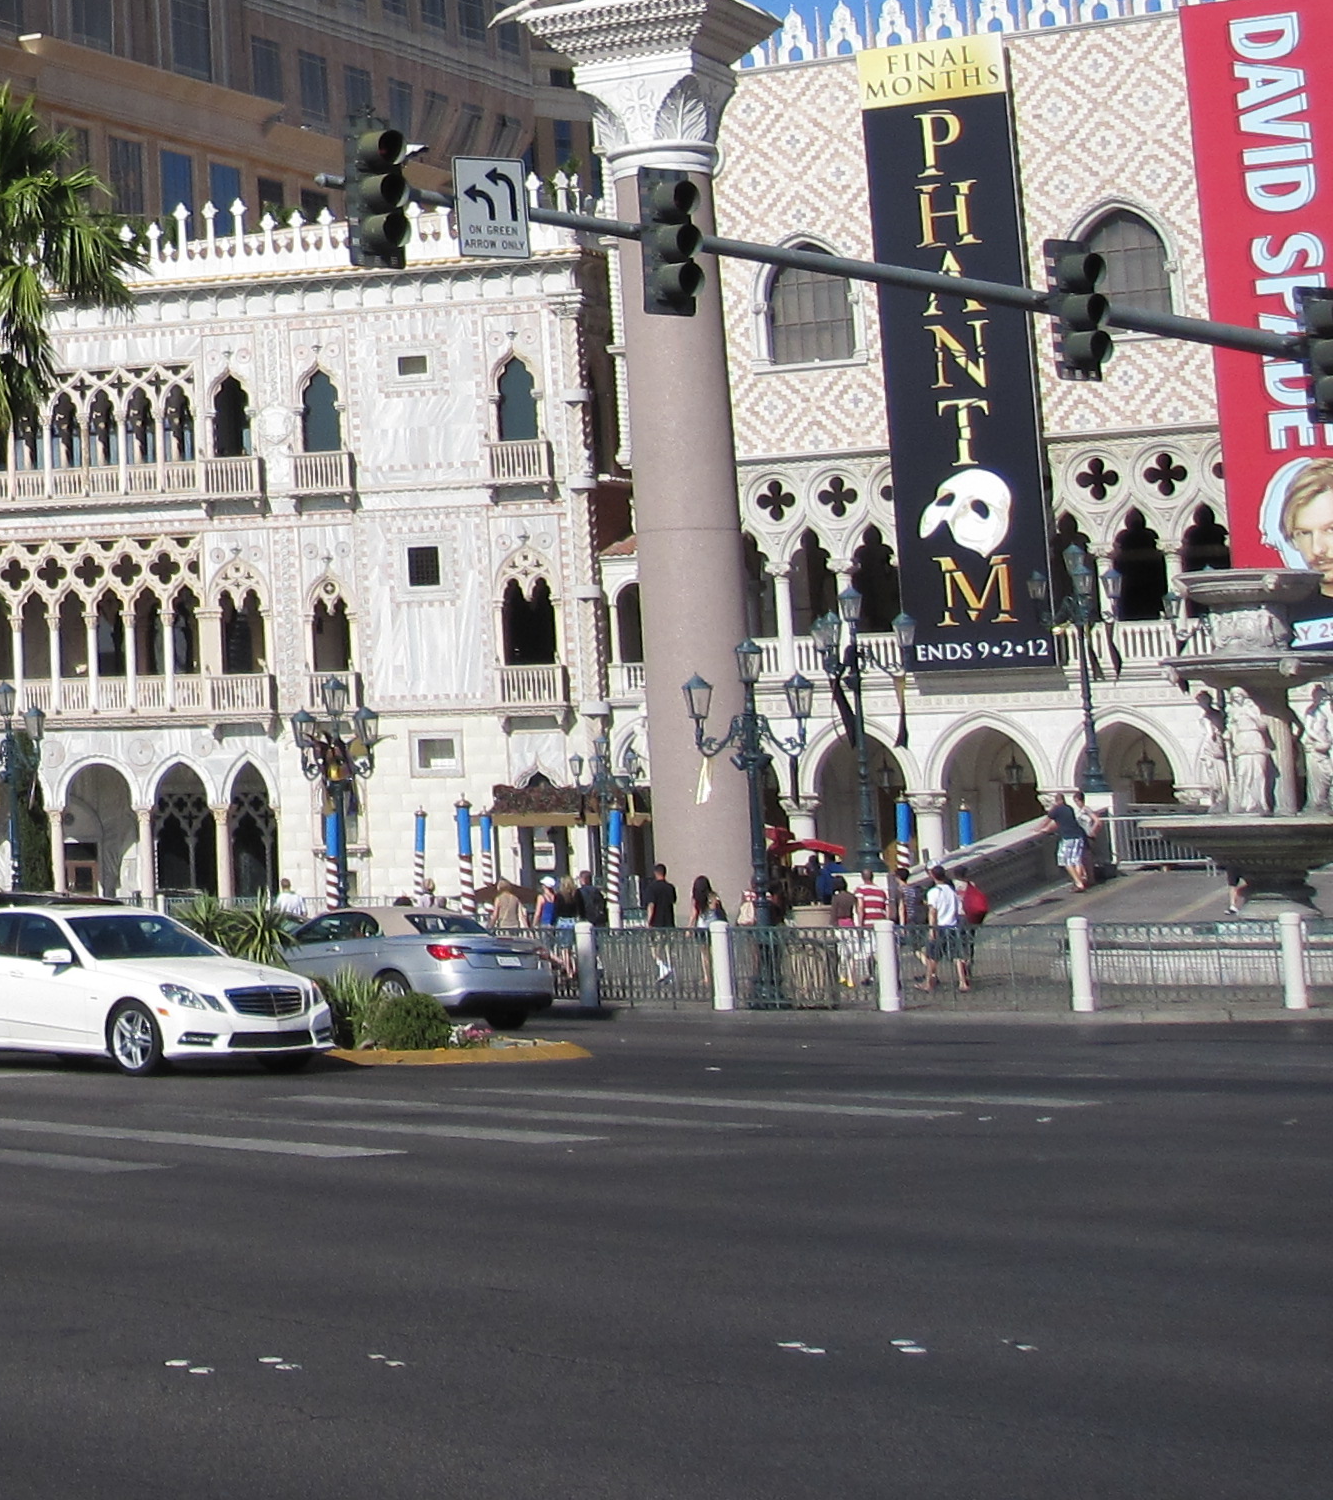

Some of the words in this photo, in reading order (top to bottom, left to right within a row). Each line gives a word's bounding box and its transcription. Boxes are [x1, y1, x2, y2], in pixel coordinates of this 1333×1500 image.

[886, 45, 975, 75] FINAL
[865, 63, 1000, 100] MONTHS
[1227, 11, 1318, 213] DAVID
[468, 224, 482, 235] ON
[487, 225, 519, 236] GREEN
[464, 239, 497, 249] ARROW
[501, 240, 526, 251] ONLY
[914, 108, 1018, 627] PHANTM
[1319, 622, 1333, 638] 2
[915, 641, 973, 662] ENDS
